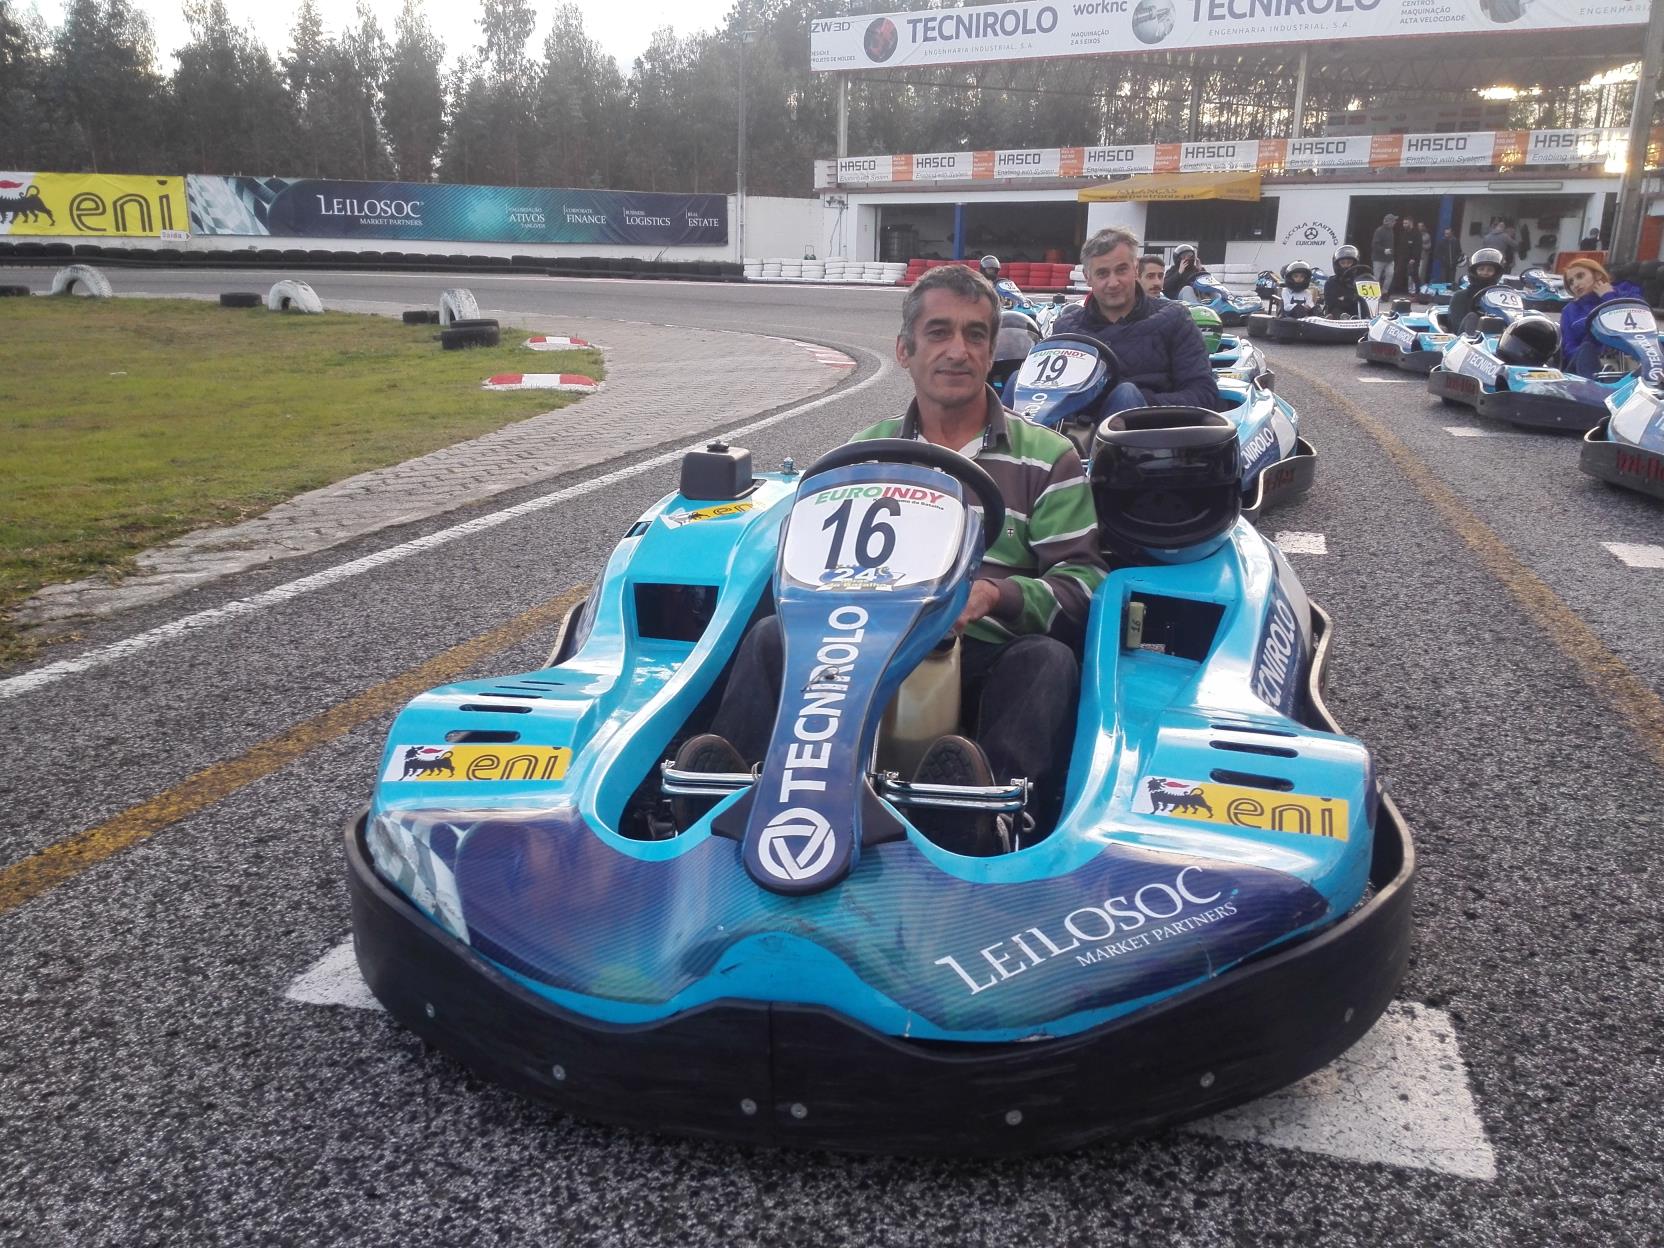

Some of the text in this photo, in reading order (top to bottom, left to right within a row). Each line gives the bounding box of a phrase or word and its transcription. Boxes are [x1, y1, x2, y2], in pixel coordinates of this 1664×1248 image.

[1073, 0, 1128, 15] worknc
[906, 6, 1058, 43] TECNIROLO
[1419, 14, 1466, 23] VELOCIDADE
[1208, 27, 1266, 36] ENGENHARIA
[924, 47, 969, 56] ENGENHARIA
[1292, 141, 1347, 156] HASCO
[1408, 137, 1468, 152] HASCO
[998, 153, 1042, 166] HASCO
[1088, 150, 1134, 163] HASCO
[1184, 145, 1236, 160] HASCO
[840, 160, 876, 172] HASCO
[916, 156, 956, 169] HASCO
[69, 179, 173, 232] eni
[316, 194, 422, 217] LEILOSOC
[360, 218, 388, 226] MARKET
[510, 213, 545, 223] ATIVOS
[566, 214, 607, 225] FINANCE
[626, 216, 671, 226] LOGISTICS
[688, 218, 719, 227] ESTATE
[1282, 220, 1340, 247] ESCOLA KARTING
[1361, 285, 1375, 297] 51
[1624, 312, 1637, 329] 4
[1033, 355, 1068, 382] 19
[1467, 351, 1498, 378] TECNIROL
[1240, 427, 1274, 470] CNIROLO
[815, 486, 945, 505] EUROINDY
[821, 497, 902, 570] 16
[1257, 599, 1296, 706] ECNIROLO
[779, 605, 869, 803] TECNIROLO
[465, 746, 562, 781] eni
[1226, 798, 1334, 838] eni
[934, 866, 1222, 996] LEILOSOC
[1076, 902, 1238, 967] MARKET PARTNERS
